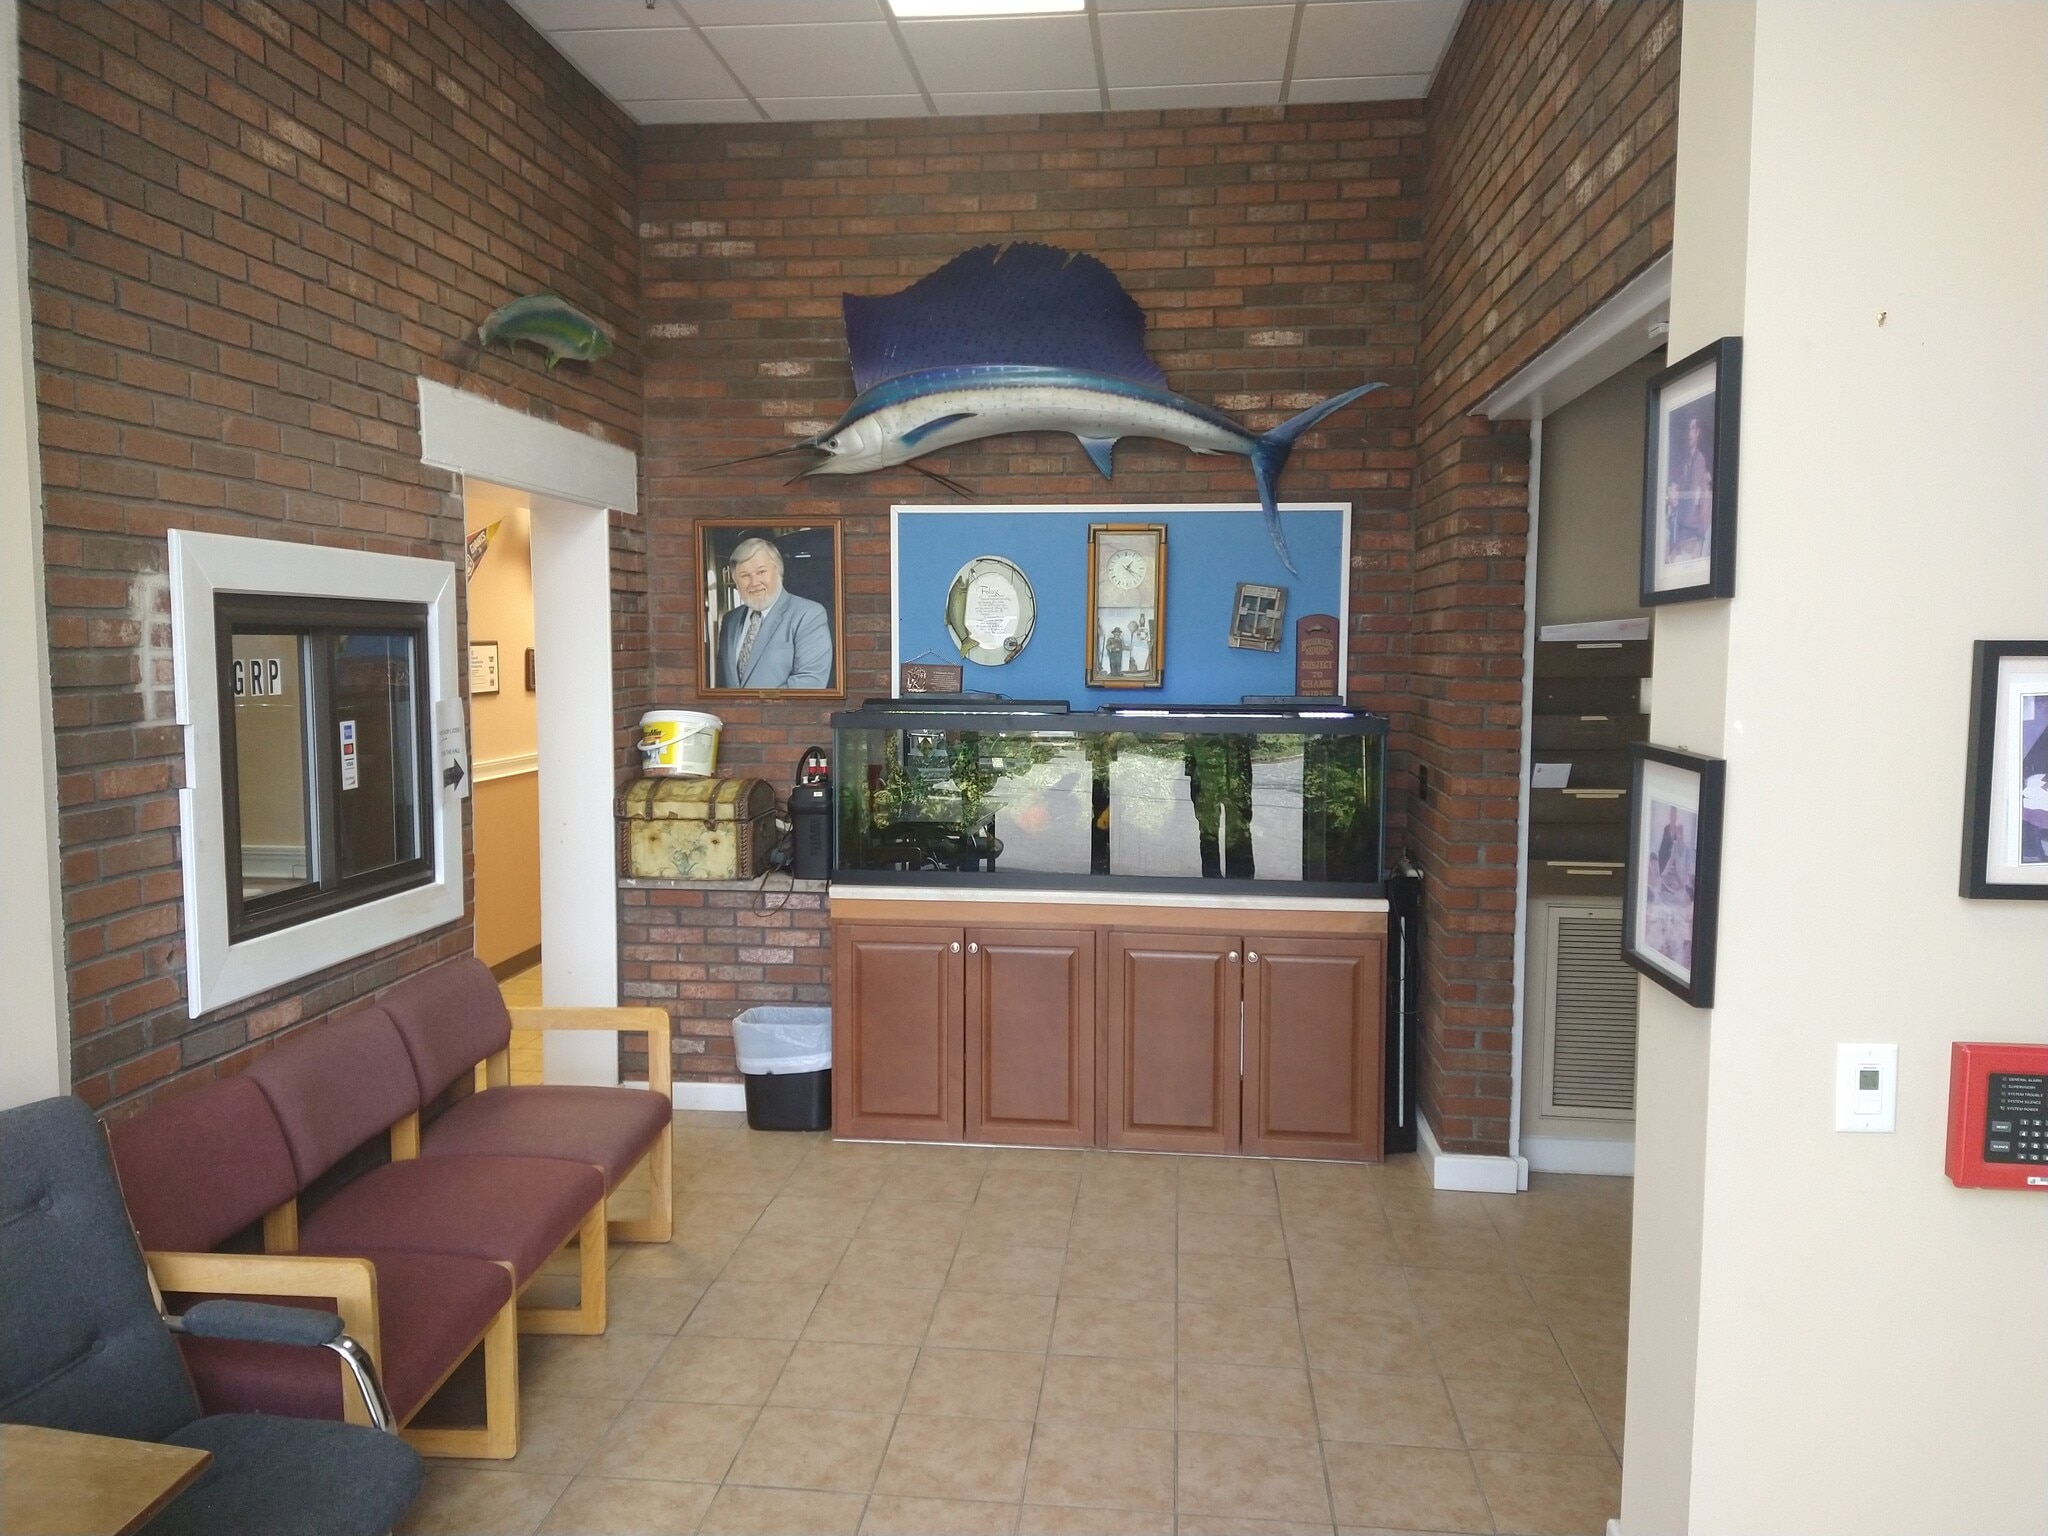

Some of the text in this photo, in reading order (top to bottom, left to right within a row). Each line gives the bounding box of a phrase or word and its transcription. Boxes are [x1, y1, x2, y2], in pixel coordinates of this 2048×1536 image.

[1301, 660, 1334, 670] SUBJECT
[233, 660, 279, 695] GRP
[1301, 679, 1334, 689] CHANGE
